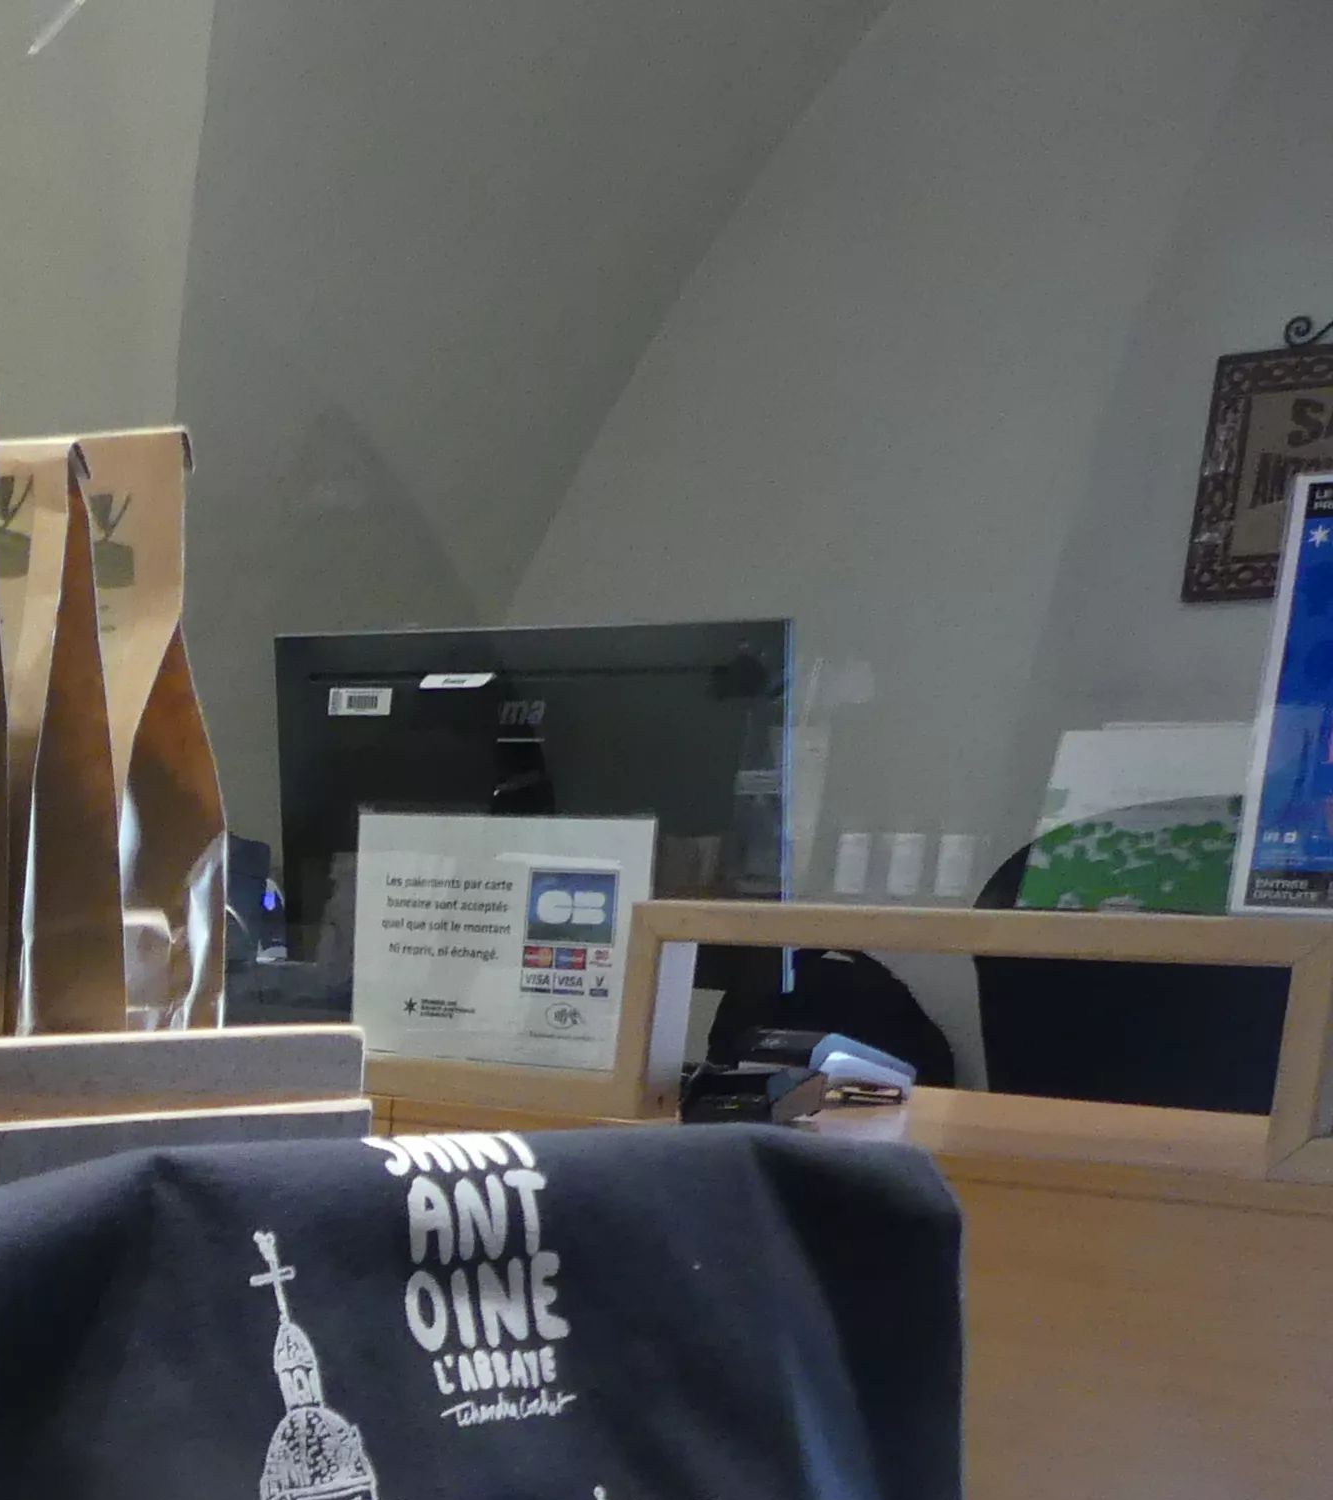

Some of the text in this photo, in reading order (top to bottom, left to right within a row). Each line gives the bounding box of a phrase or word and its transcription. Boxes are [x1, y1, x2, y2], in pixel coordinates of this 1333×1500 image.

[1288, 398, 1333, 448] S
[386, 873, 514, 892] Les paiements par carte
[386, 896, 509, 914] bancaire sont acceptés
[382, 918, 512, 935] quel que soit le montant
[388, 942, 400, 954] Ni
[437, 946, 449, 957] ni
[525, 973, 551, 986] VISA
[556, 975, 584, 988] VISA
[407, 1169, 548, 1265] ANT
[404, 1251, 571, 1352] OINE
[433, 1346, 557, 1394] L'ABBAYE
